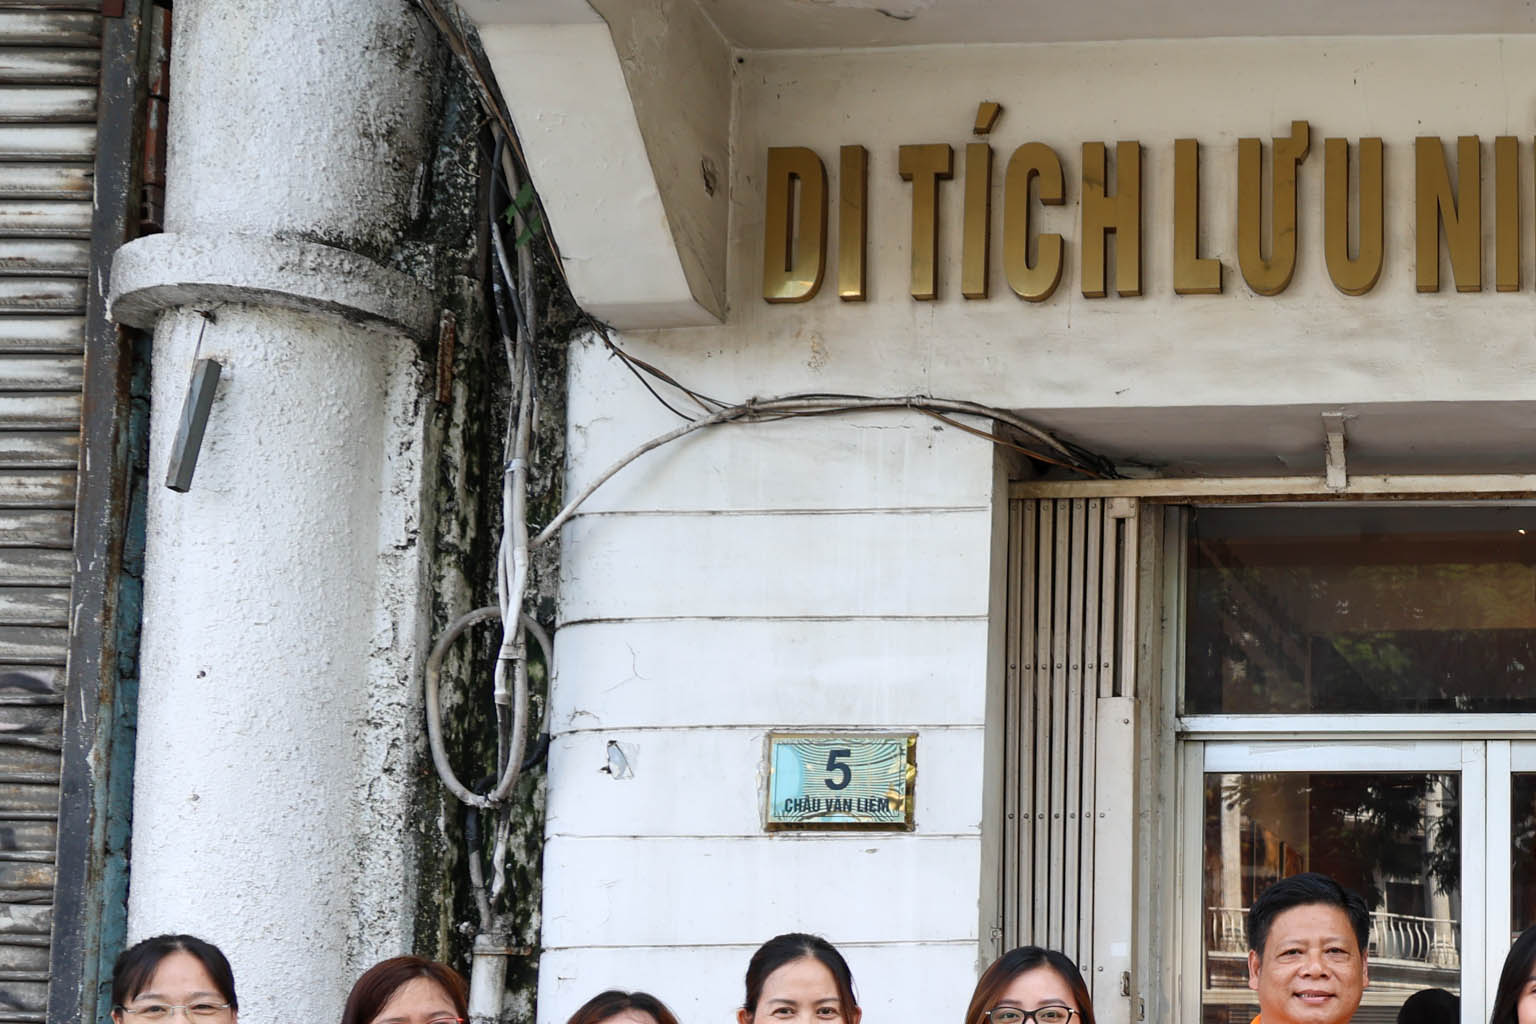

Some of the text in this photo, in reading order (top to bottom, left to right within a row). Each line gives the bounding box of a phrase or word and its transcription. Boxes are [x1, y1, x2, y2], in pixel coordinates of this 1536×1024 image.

[763, 143, 867, 303] DI
[898, 101, 1142, 302] TÍCH
[1173, 120, 1385, 296] LƯU
[824, 749, 852, 790] 5
[784, 795, 820, 813] CHÂU
[857, 795, 890, 813] LIÊM
